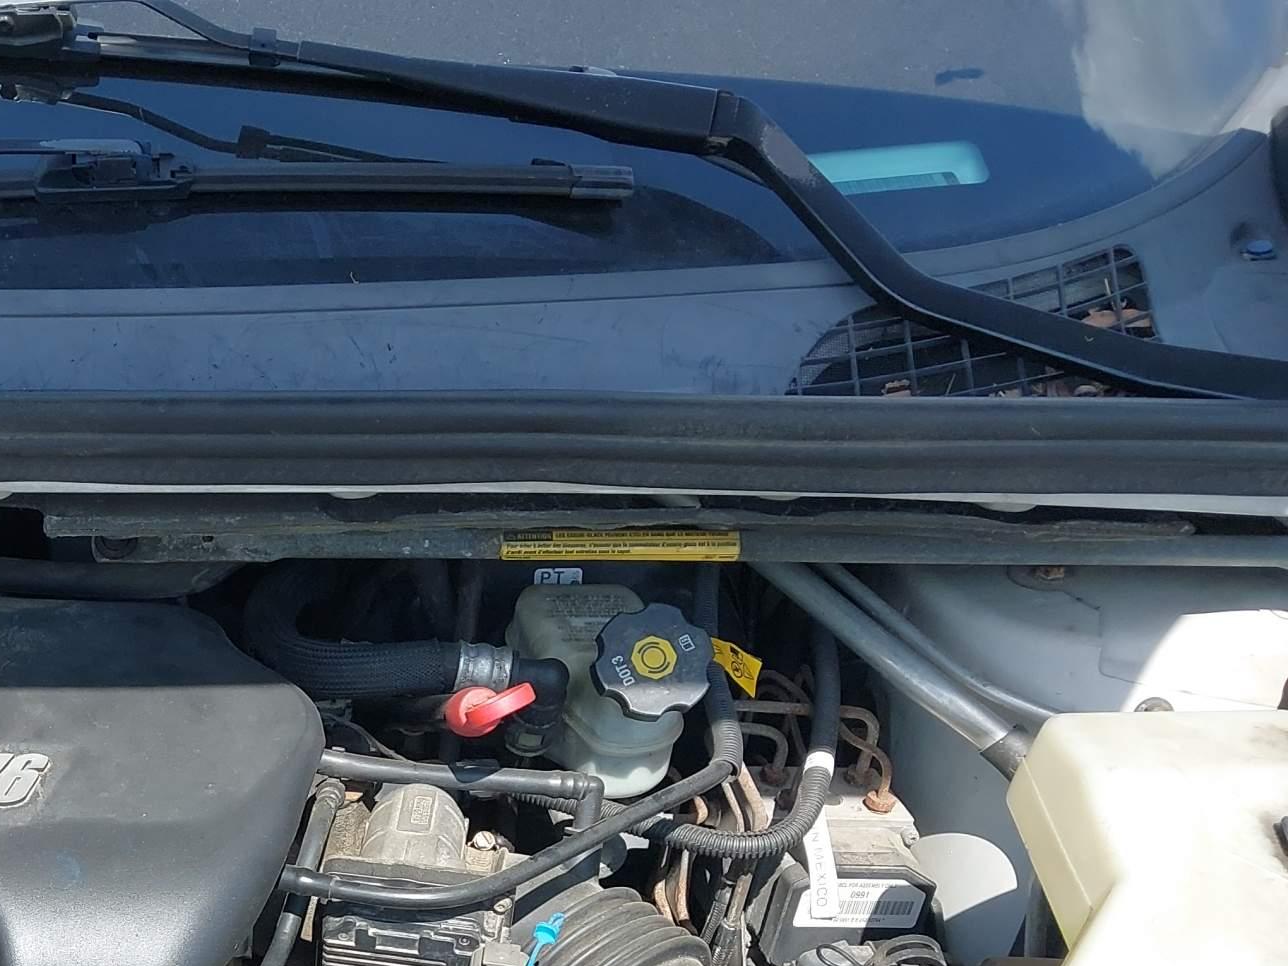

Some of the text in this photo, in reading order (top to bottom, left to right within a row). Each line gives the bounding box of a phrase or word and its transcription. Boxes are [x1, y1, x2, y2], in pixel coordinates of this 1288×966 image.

[611, 654, 635, 687] DOT 3
[814, 848, 828, 907] MEXICO
